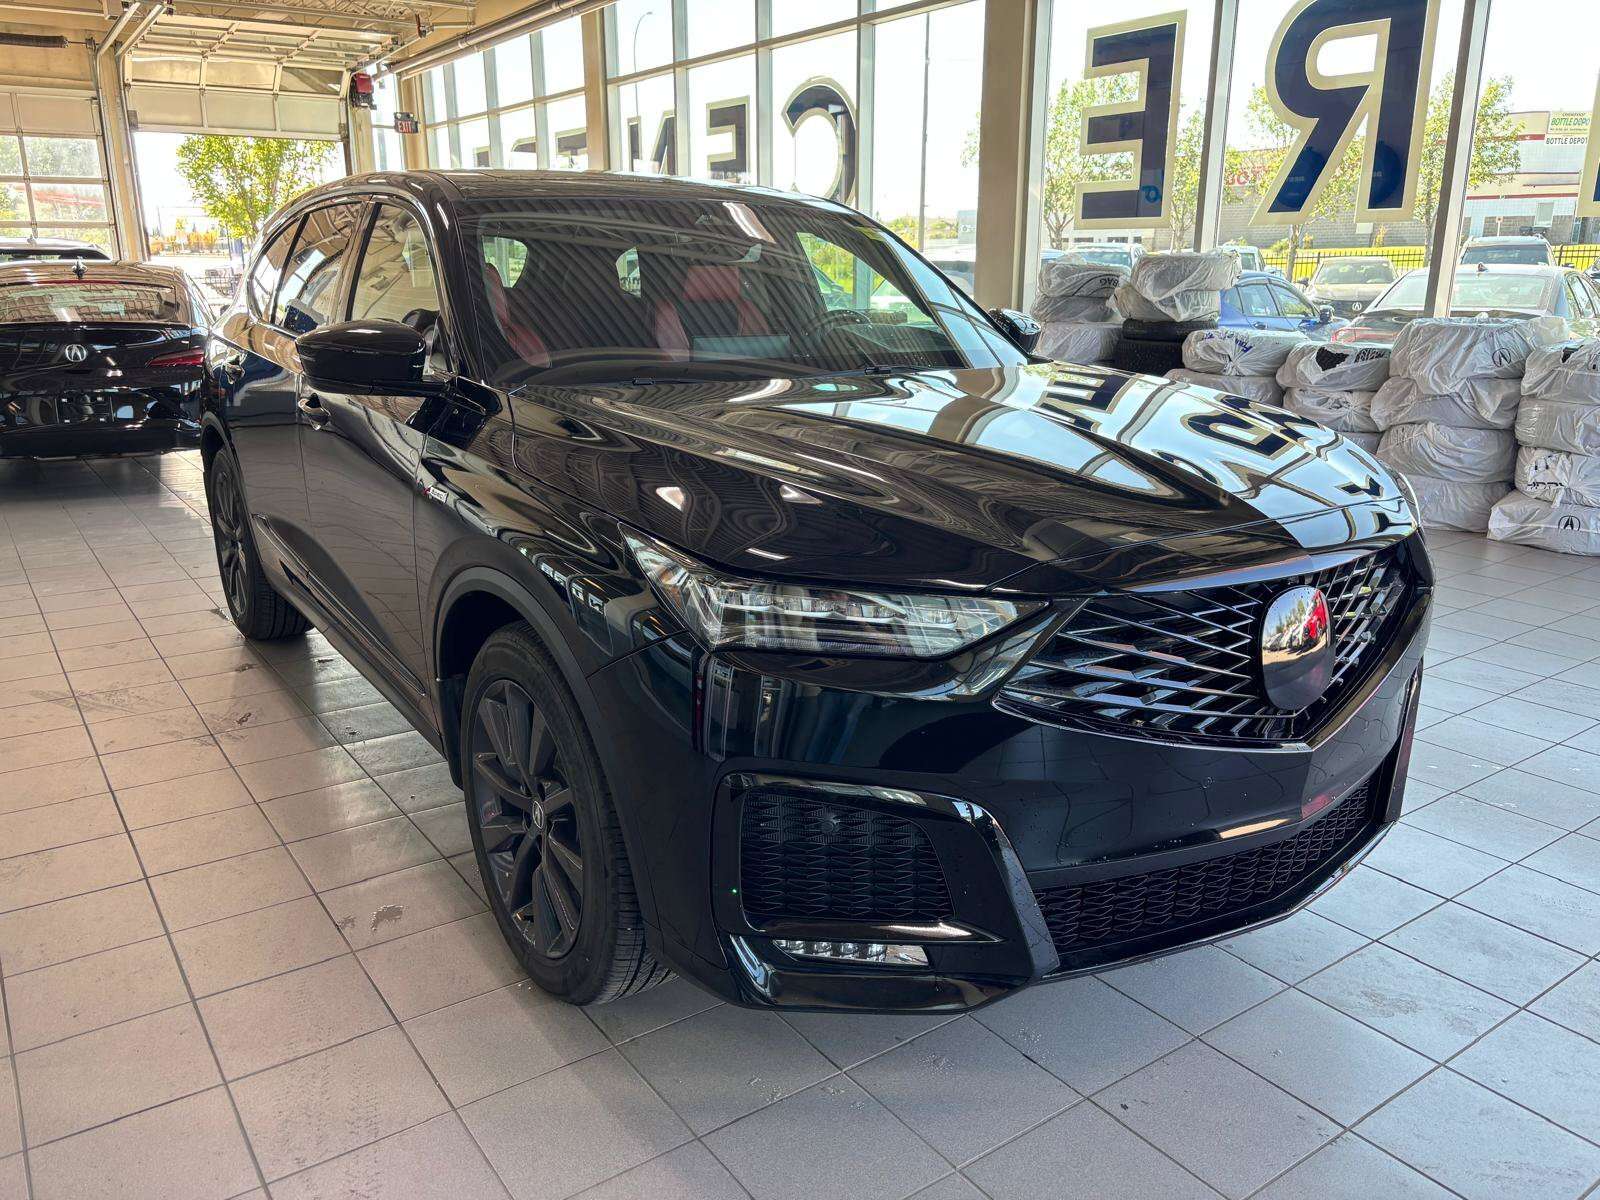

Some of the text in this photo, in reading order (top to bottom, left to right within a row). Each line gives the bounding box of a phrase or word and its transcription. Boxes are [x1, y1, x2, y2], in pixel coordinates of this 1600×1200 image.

[1573, 117, 1590, 126] DEPO
[398, 121, 412, 133] EXIT
[1546, 137, 1568, 145] BOTTLE
